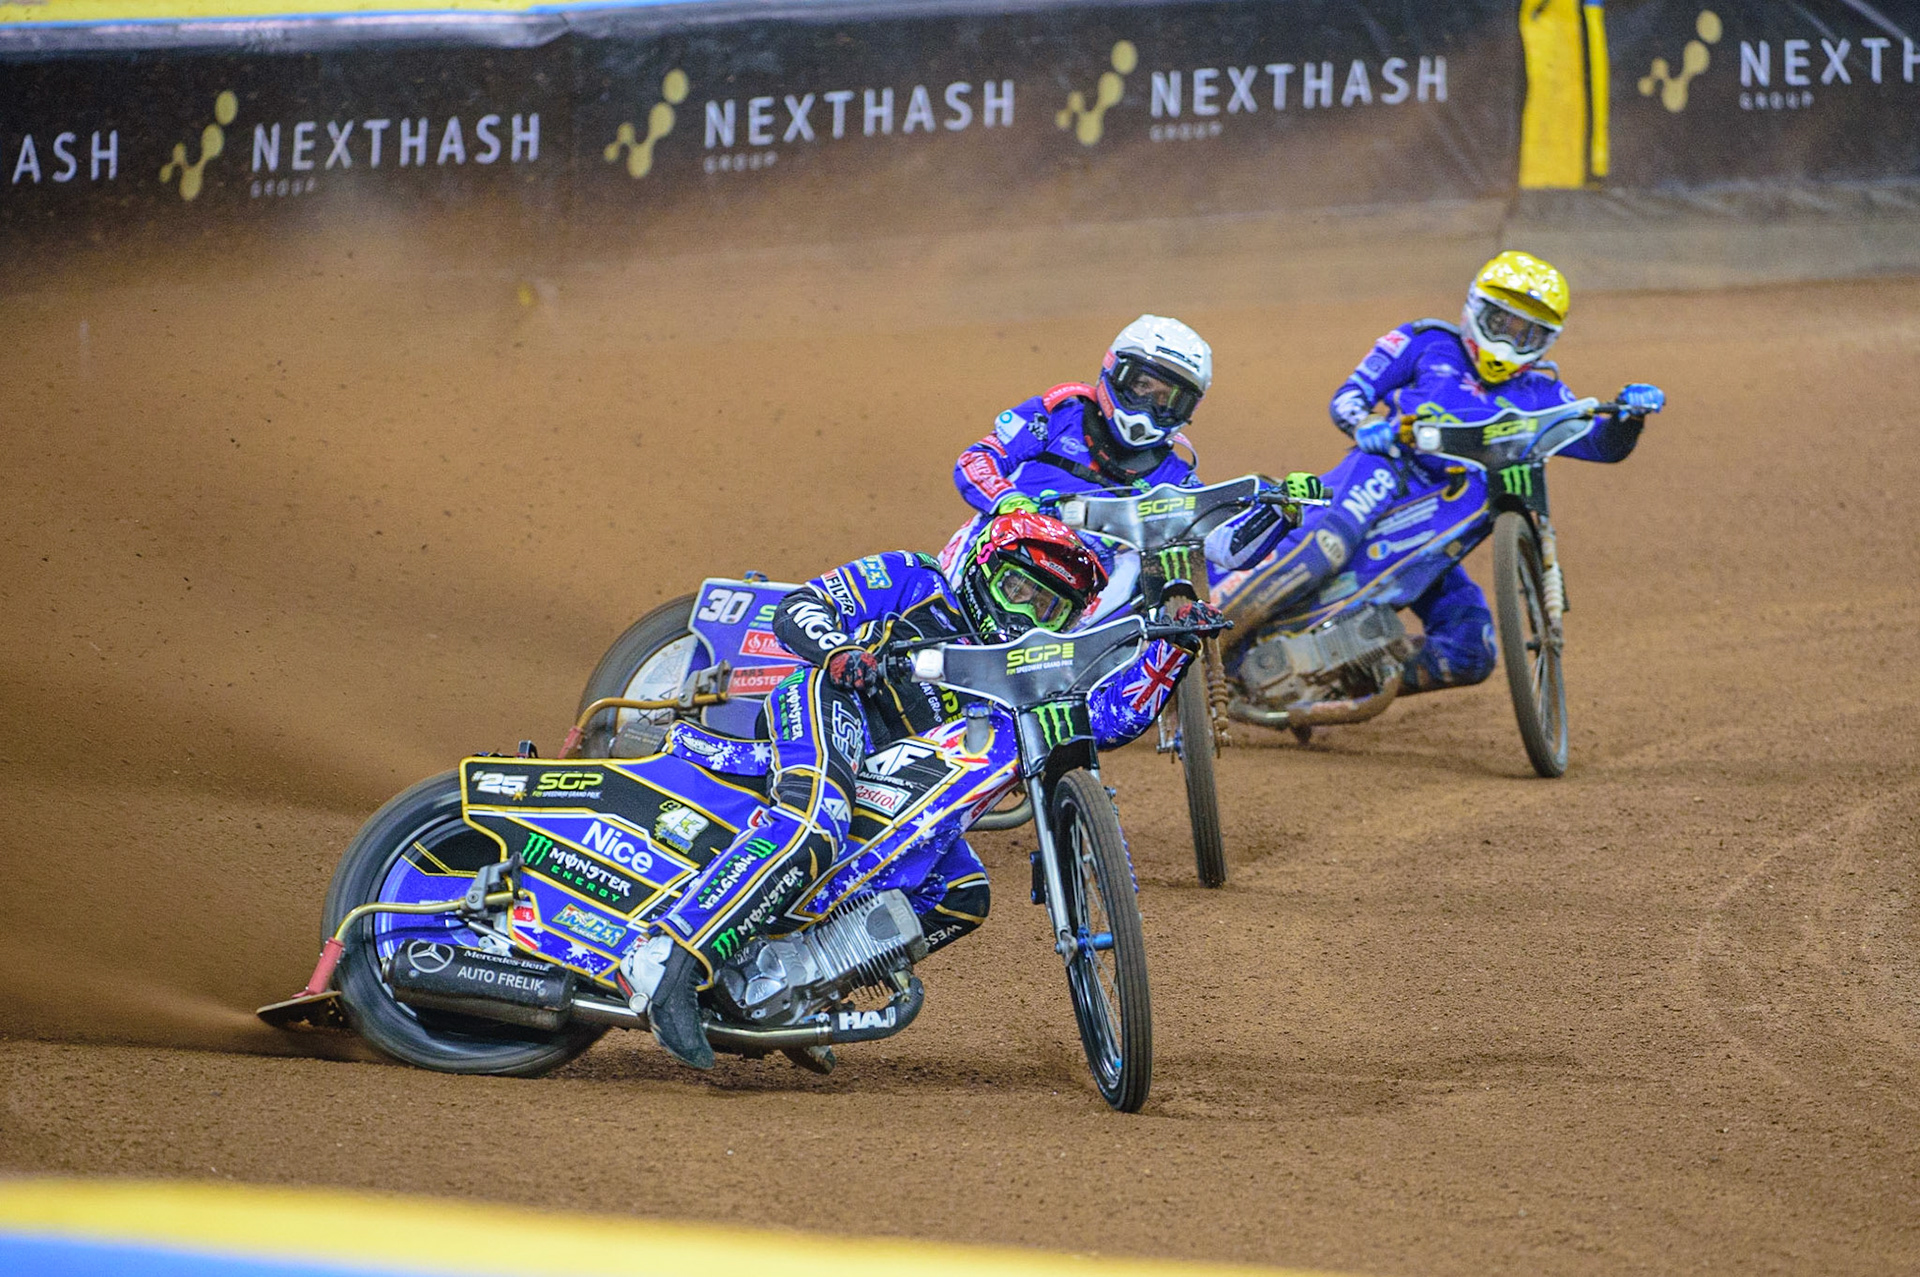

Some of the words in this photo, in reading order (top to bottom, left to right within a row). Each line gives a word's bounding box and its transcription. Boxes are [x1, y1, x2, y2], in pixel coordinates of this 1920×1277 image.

[704, 79, 1015, 149] NEXTHASH
[1150, 55, 1448, 118] NEXTHASH
[11, 129, 119, 185] ASH
[251, 112, 540, 173] NEXTHASH
[1342, 468, 1396, 524] Nice
[698, 588, 754, 625] 30
[826, 575, 855, 615] FILTER
[786, 601, 849, 651] Nice
[786, 684, 804, 742] MONSTER
[537, 771, 604, 791] SGP
[548, 847, 632, 897] MONSTER
[581, 820, 654, 875] Nice
[550, 864, 621, 903] ENERGY
[699, 854, 757, 911] MONSTER
[737, 866, 805, 936] MONSTER
[457, 965, 496, 984] AUTO
[497, 972, 545, 991] FRELIK
[463, 950, 555, 972] Mercedes-Benz
